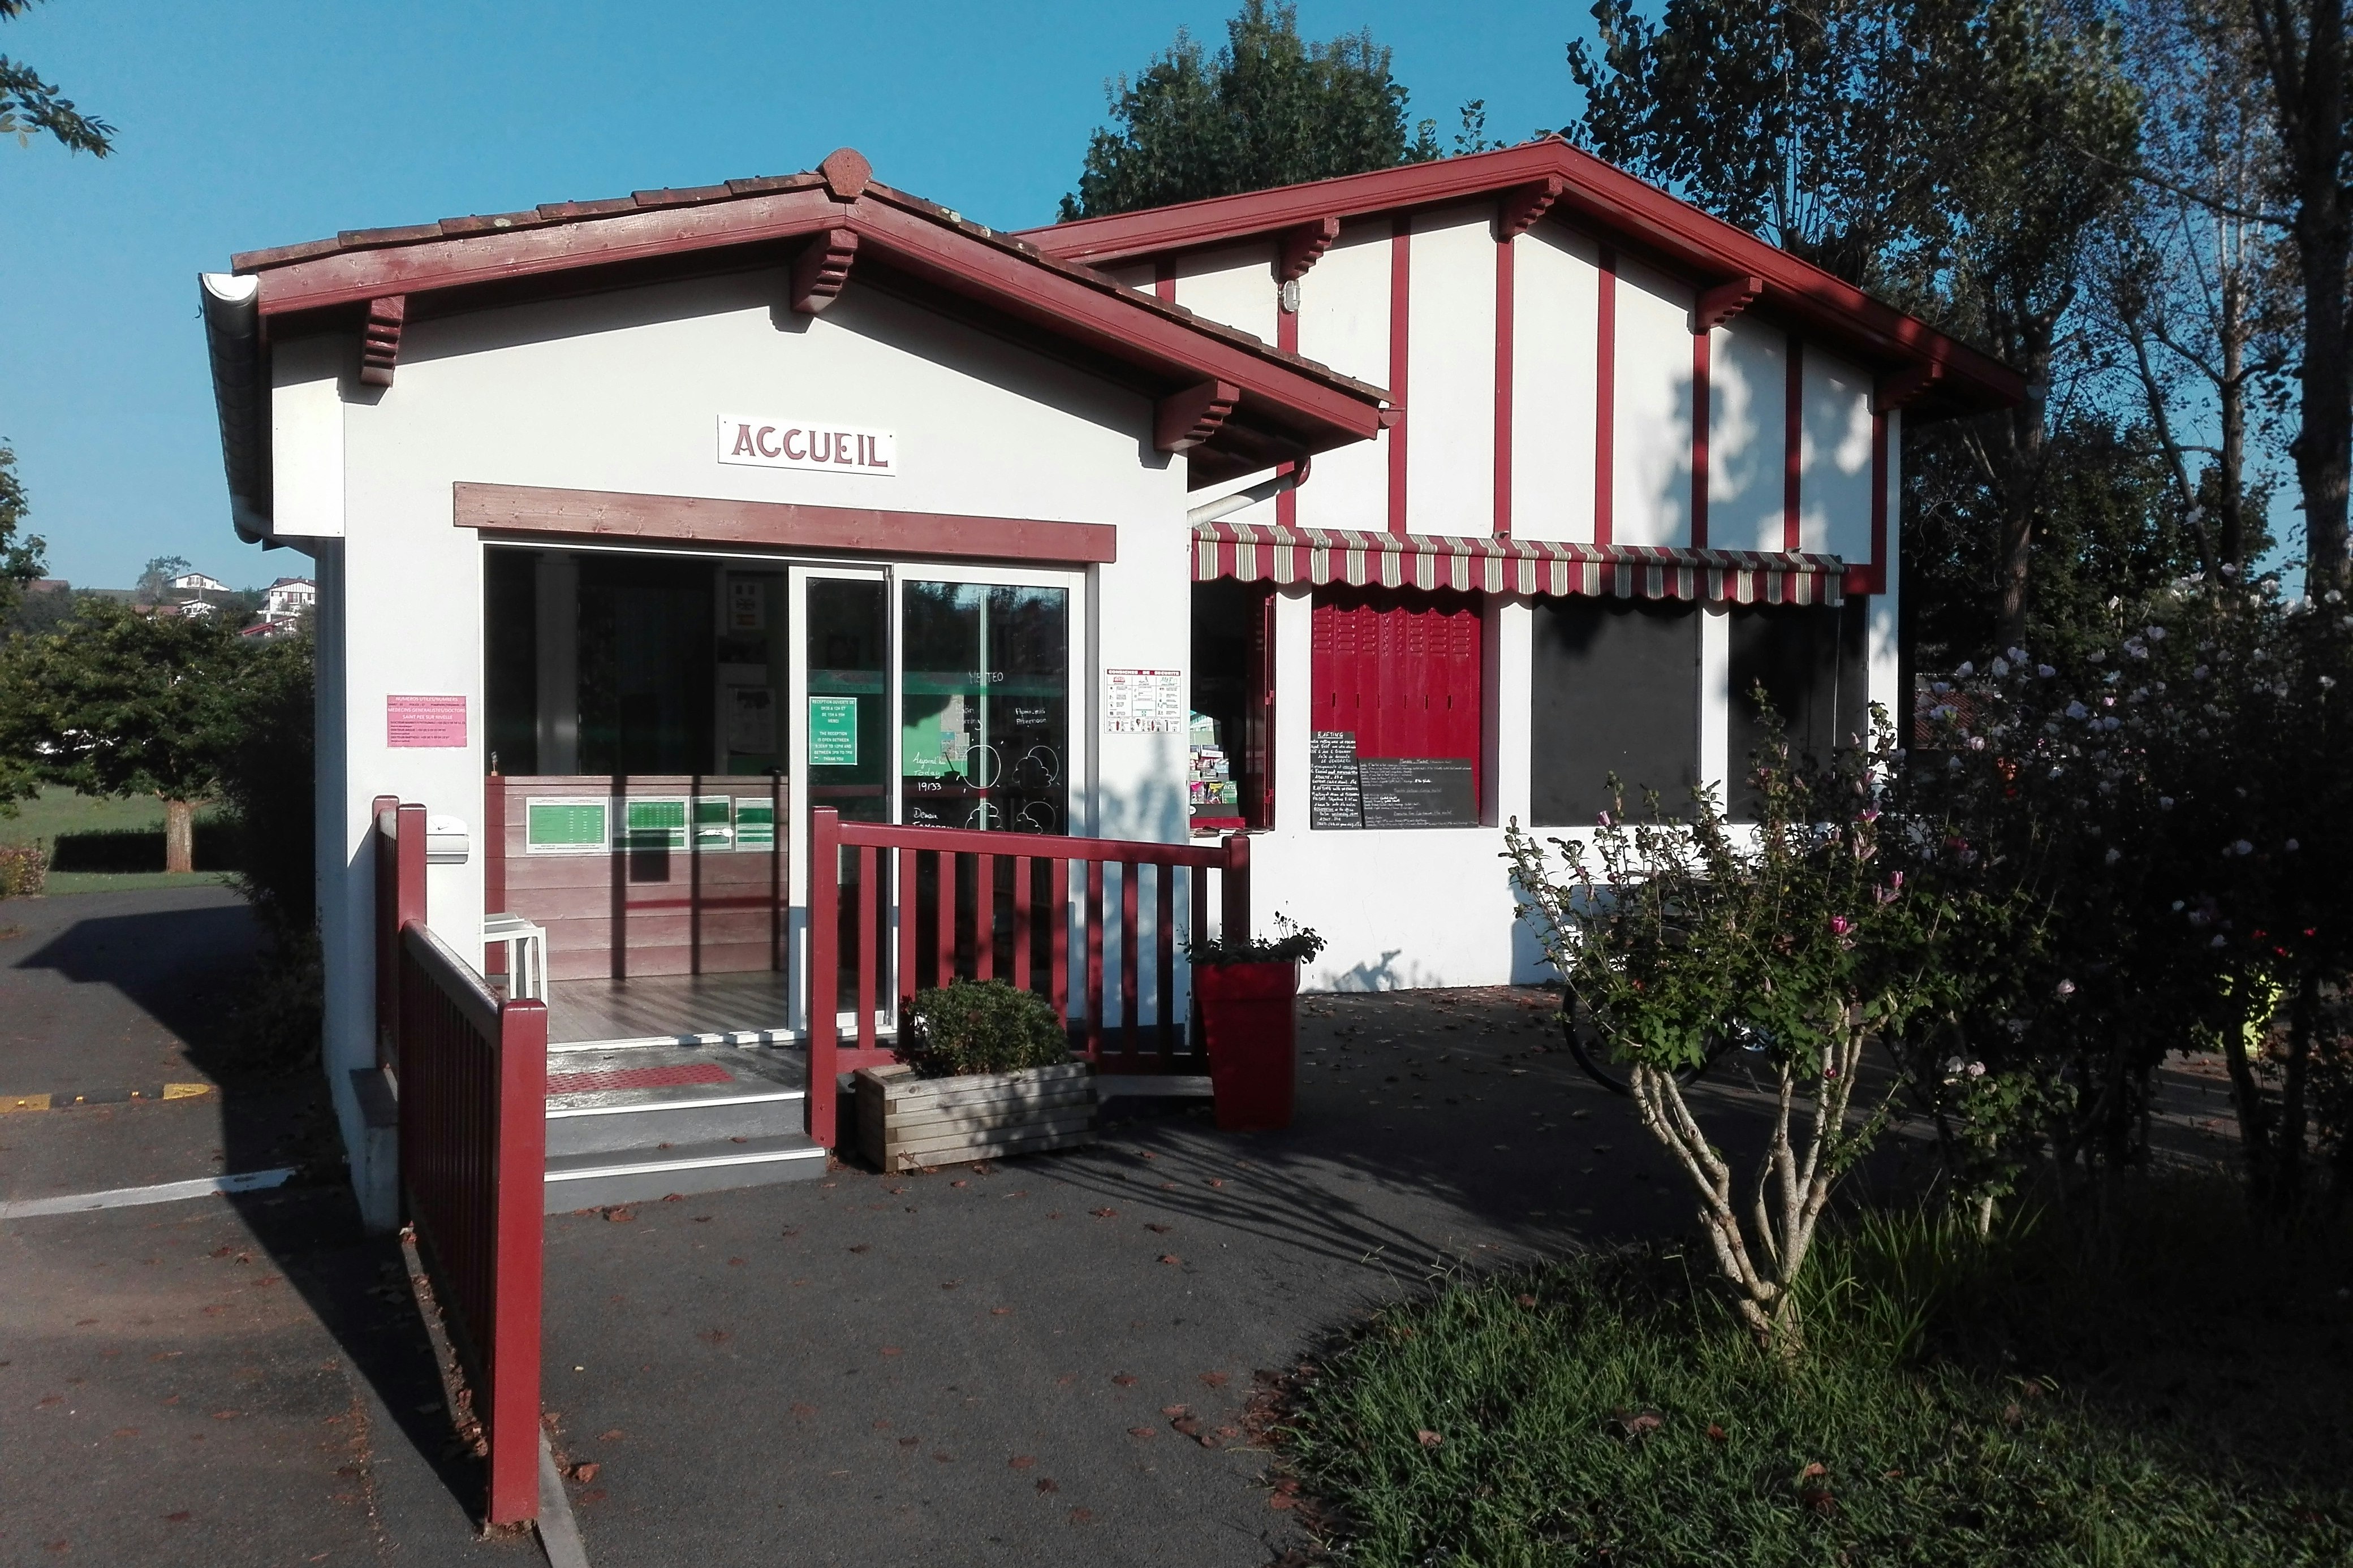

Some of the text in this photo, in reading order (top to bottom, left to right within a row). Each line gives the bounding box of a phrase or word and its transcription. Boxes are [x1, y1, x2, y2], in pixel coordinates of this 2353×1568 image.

[731, 424, 888, 468] ACCUEIL
[914, 767, 940, 779] Today
[913, 807, 938, 819] Demain
